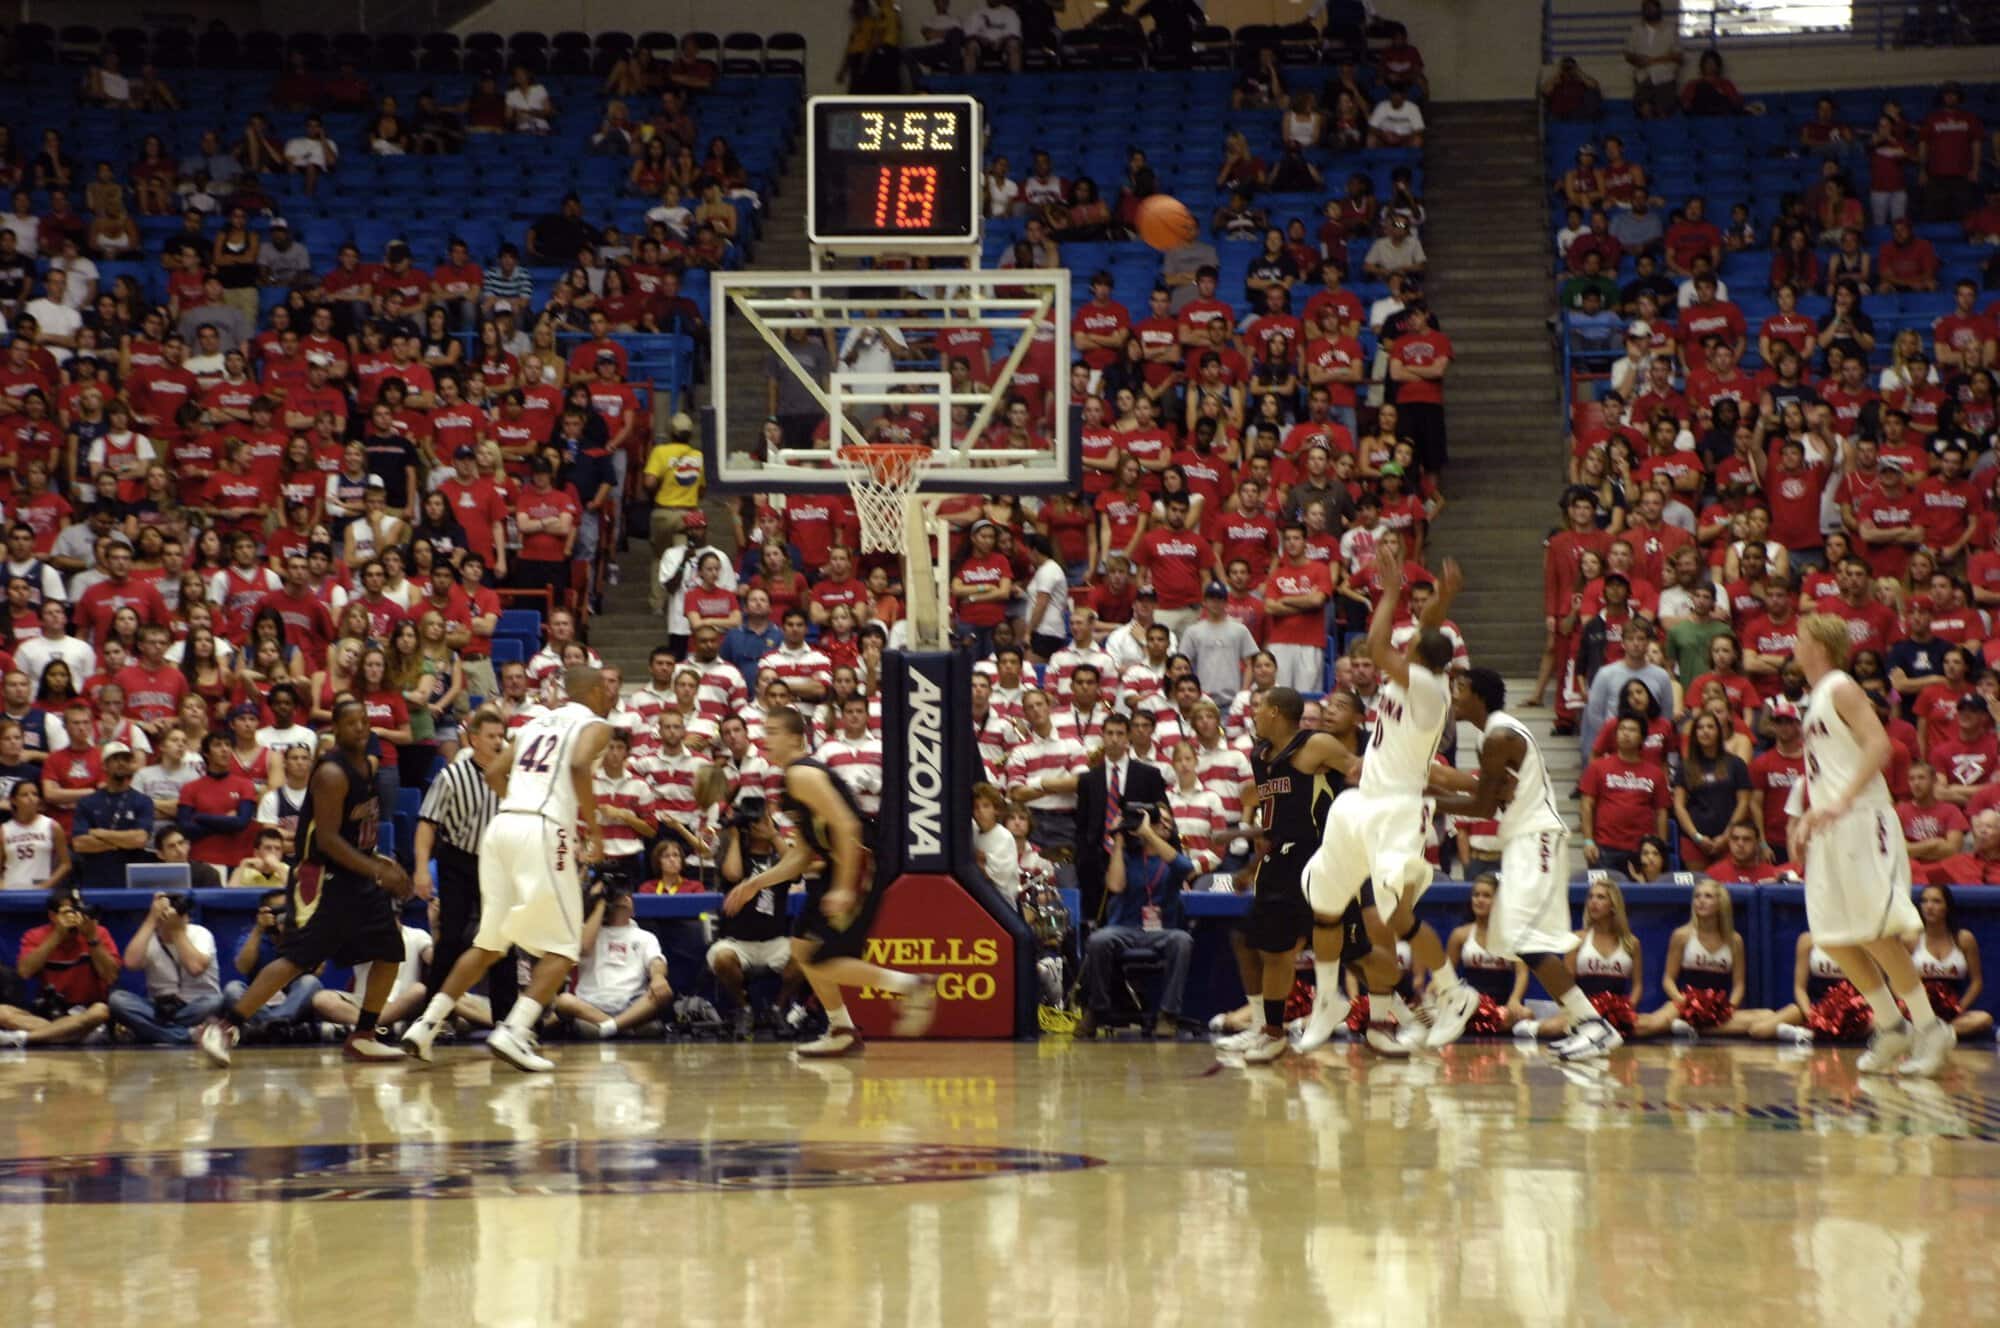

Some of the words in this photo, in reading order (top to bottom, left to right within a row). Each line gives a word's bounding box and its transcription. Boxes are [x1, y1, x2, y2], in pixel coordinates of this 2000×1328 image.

[858, 112, 956, 150] 3:52
[875, 166, 937, 228] 18
[519, 734, 559, 773] 42
[908, 664, 942, 858] ARIZONA
[555, 827, 568, 871] CATS
